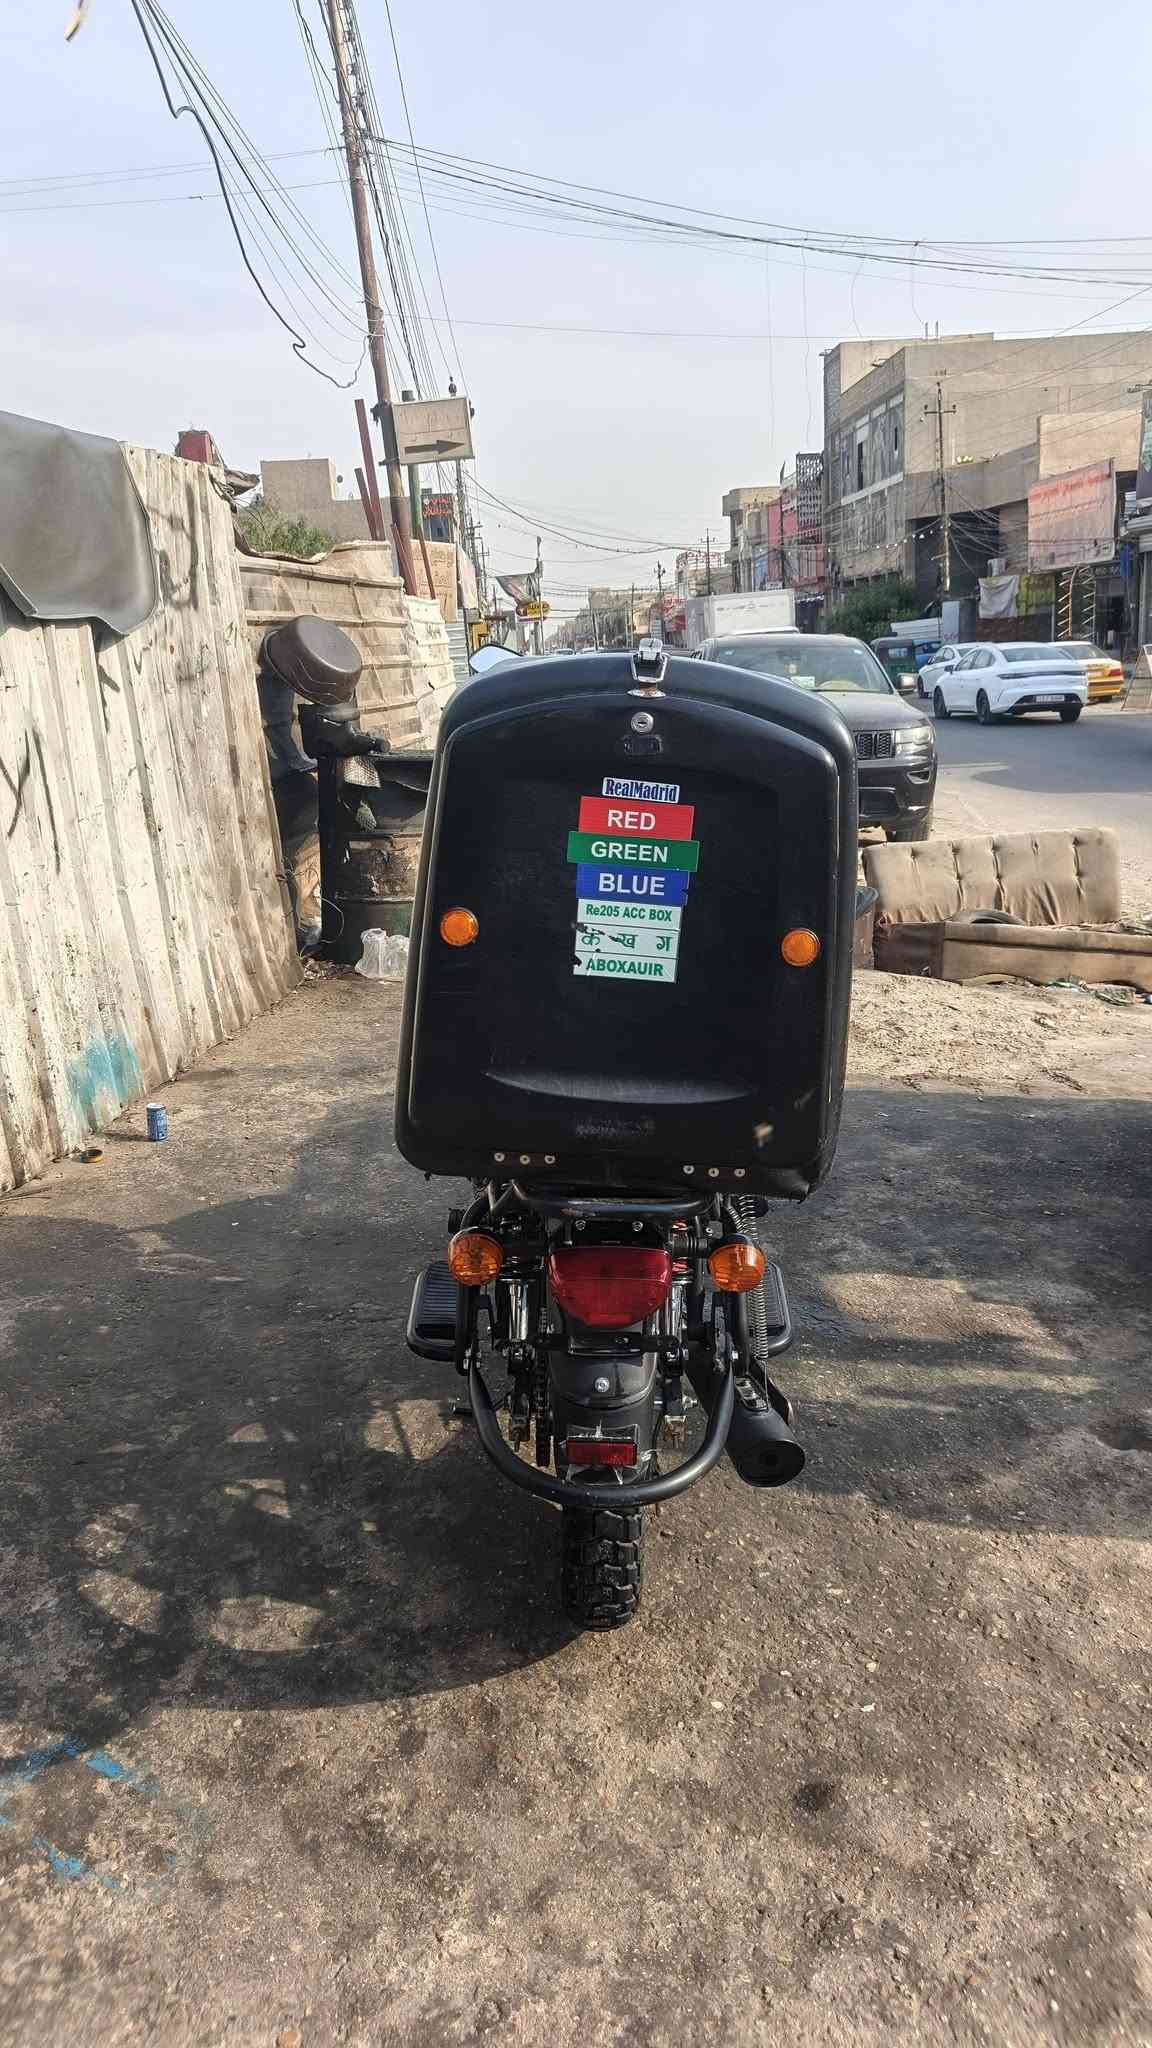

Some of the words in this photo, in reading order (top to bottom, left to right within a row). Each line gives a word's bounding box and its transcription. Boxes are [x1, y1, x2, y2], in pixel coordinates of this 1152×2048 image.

[604, 778, 679, 802] RealMadrid
[607, 809, 656, 831] RED
[590, 841, 668, 863] GREEN
[598, 872, 665, 896] BLUE
[585, 903, 620, 918] Re205
[622, 906, 647, 919] ACC
[648, 908, 673, 922] BOX
[655, 935, 673, 952] ग
[585, 957, 664, 977] ABOXAUIR
